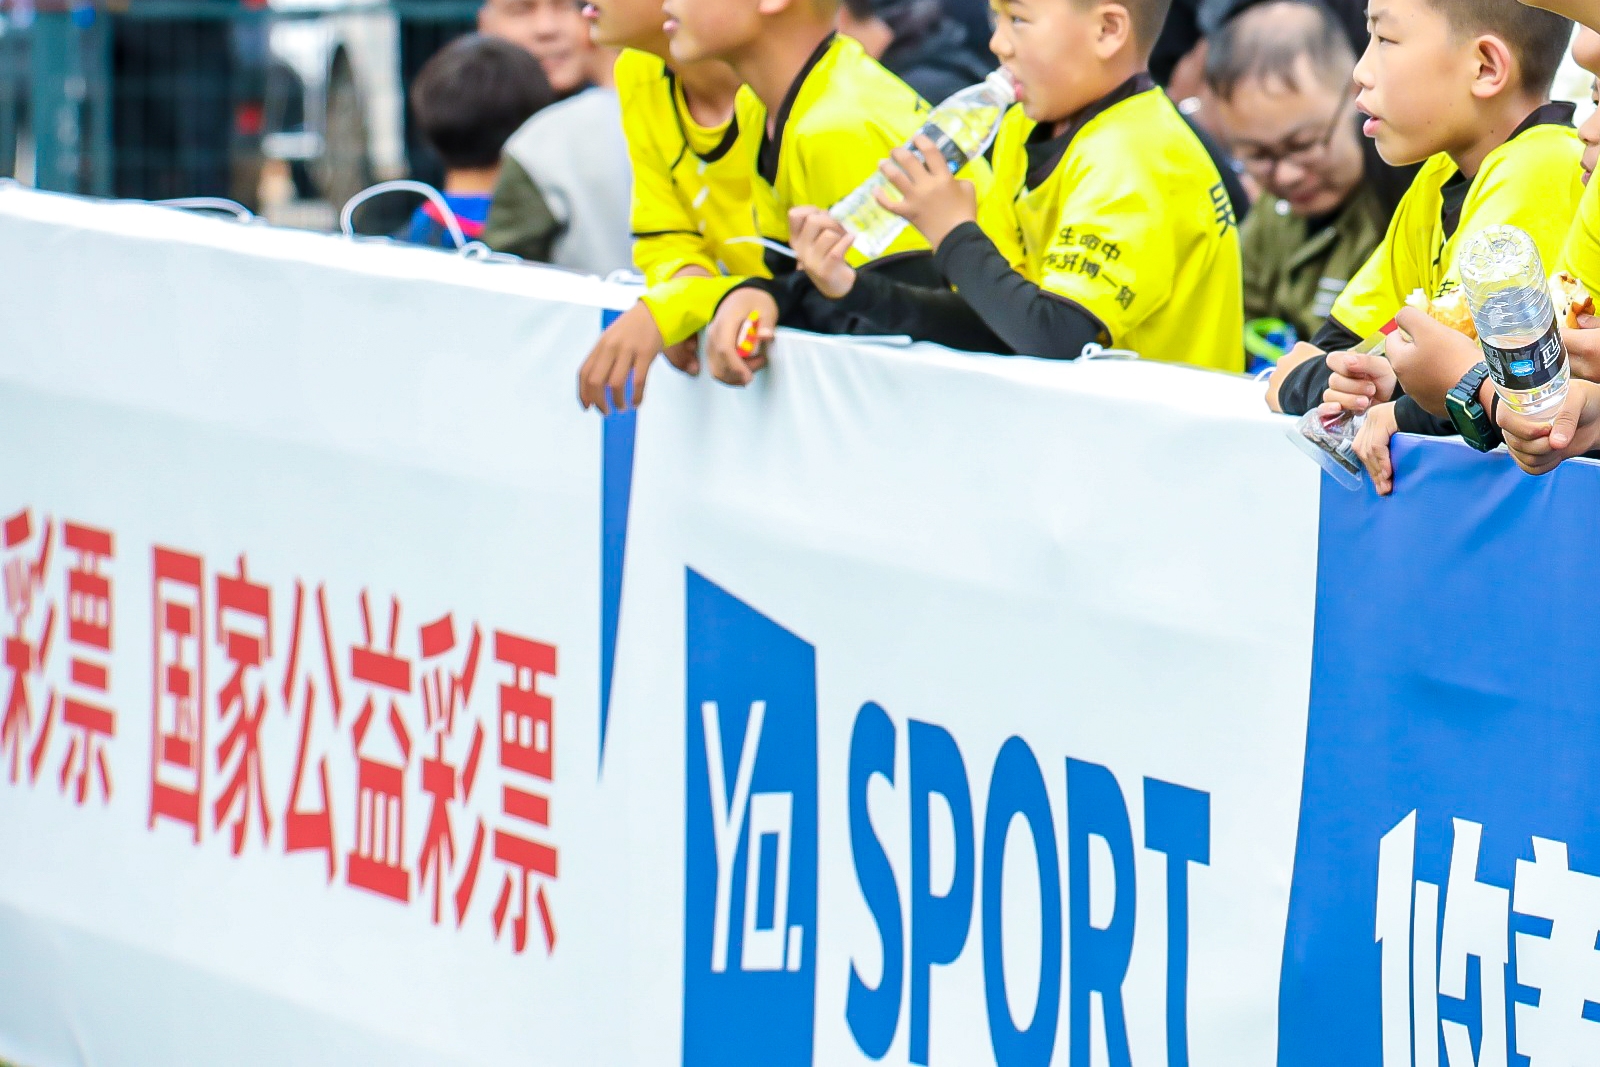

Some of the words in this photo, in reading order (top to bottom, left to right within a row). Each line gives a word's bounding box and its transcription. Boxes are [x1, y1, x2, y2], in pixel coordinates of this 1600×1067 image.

[0, 507, 116, 805] 彩票
[148, 543, 560, 959] 国家公益彩票
[845, 700, 1211, 1067] SPORT
